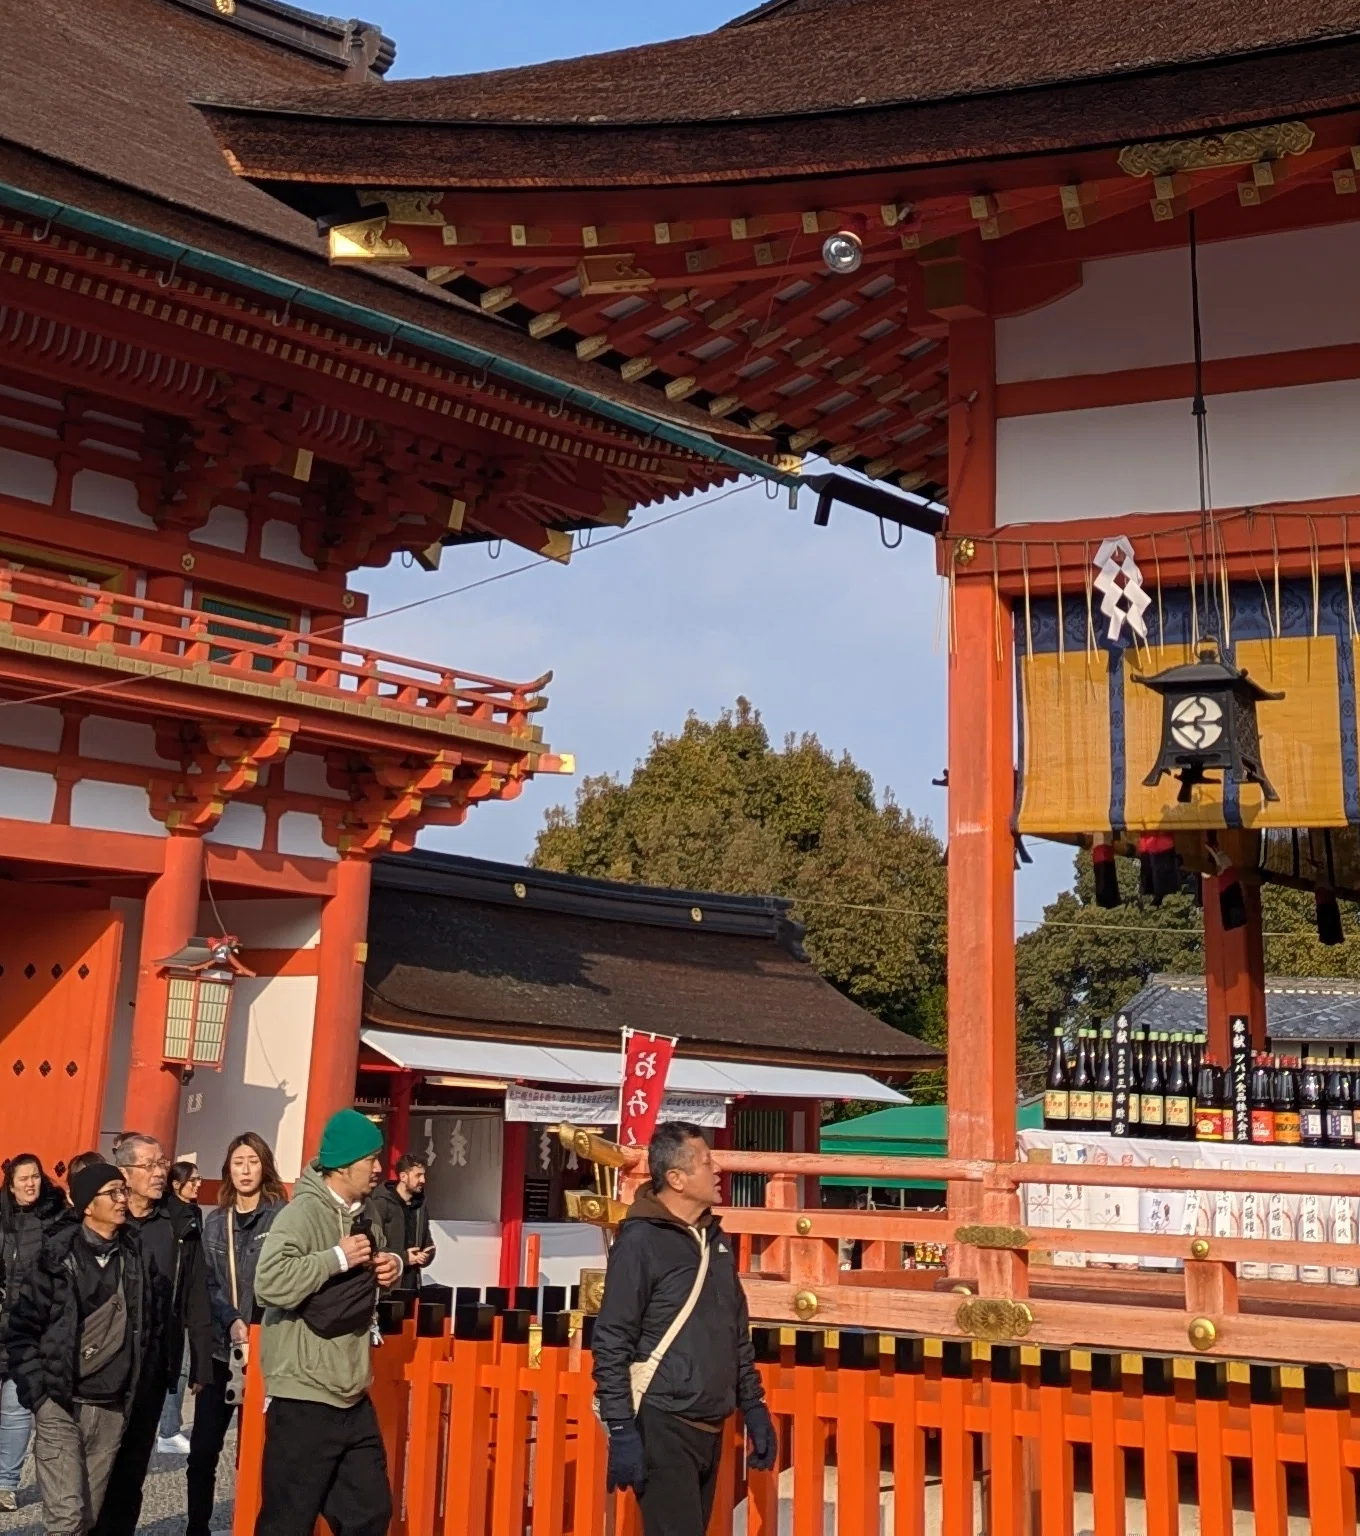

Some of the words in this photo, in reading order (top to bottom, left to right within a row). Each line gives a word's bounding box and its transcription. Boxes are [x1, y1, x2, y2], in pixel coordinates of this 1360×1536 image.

[1233, 1053, 1249, 1141] ツバメ食品株式会社
